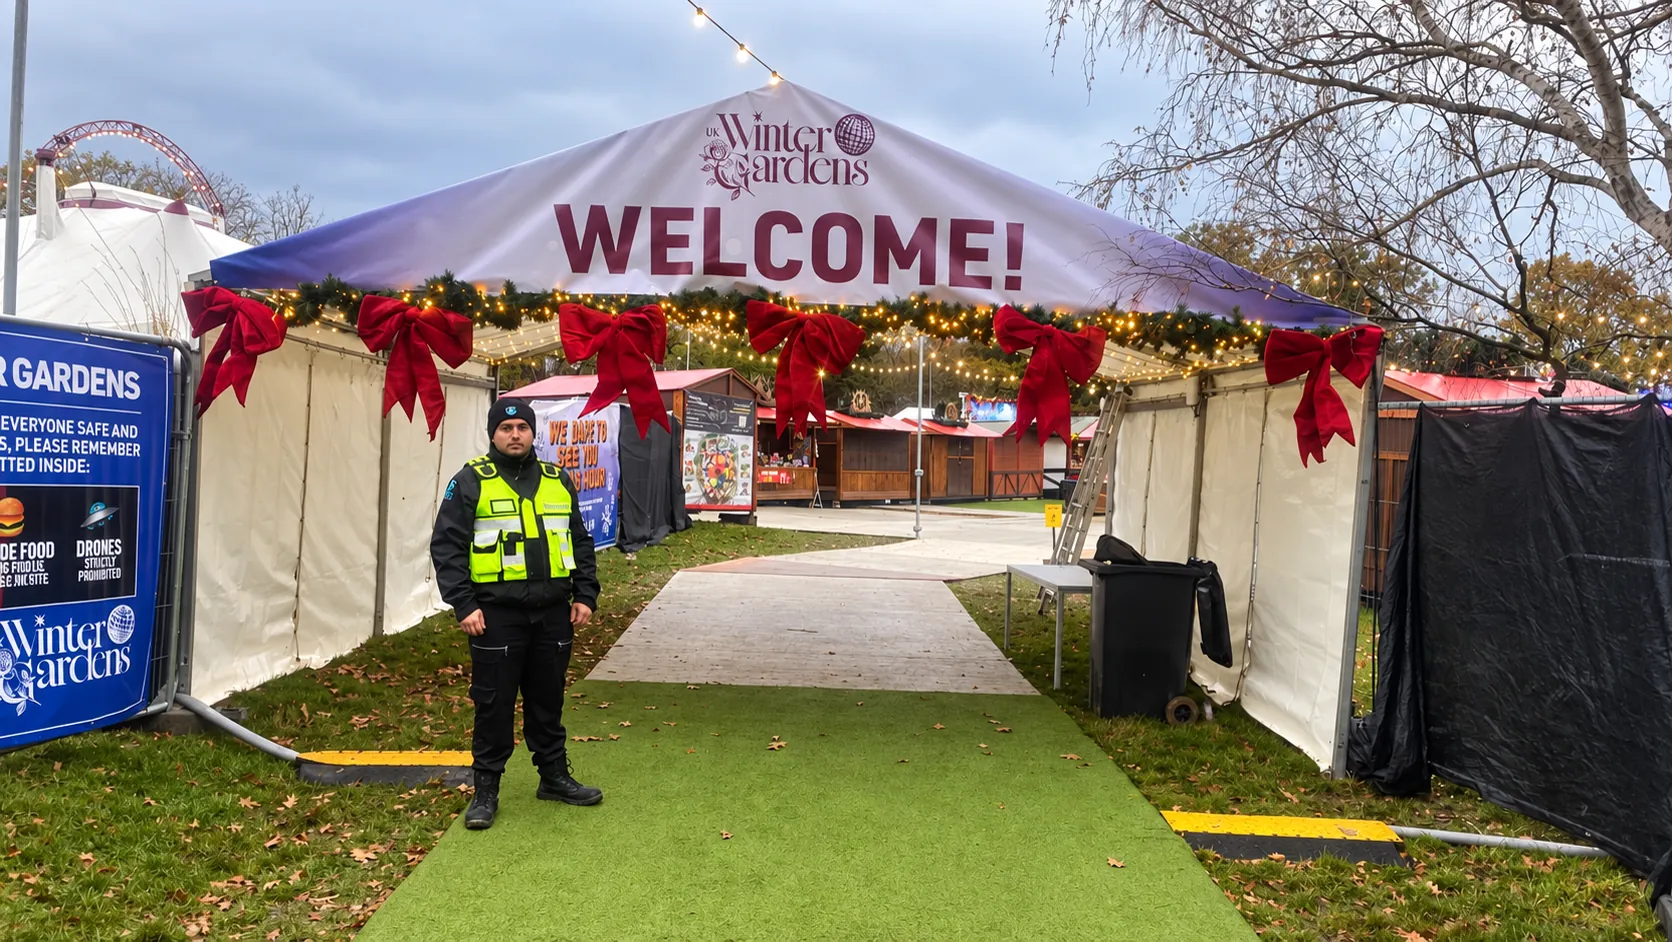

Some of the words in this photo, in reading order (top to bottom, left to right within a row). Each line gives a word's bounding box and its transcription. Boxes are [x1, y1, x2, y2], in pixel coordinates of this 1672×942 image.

[706, 127, 720, 137] UK
[716, 111, 832, 153] Winter
[713, 144, 869, 190] Gardens
[553, 203, 1025, 291] WELCOME!
[12, 357, 141, 400] GARDENS
[1, 416, 74, 434] EVERYONE
[77, 420, 109, 437] SAFE
[112, 424, 138, 439] AND
[549, 420, 568, 445] WE
[15, 437, 68, 454] PLEASE
[72, 440, 141, 457] REMEMBER
[556, 445, 580, 469] SEE
[582, 445, 599, 468] YOU
[38, 457, 91, 473] INSIDE:
[0, 542, 18, 560] DE
[20, 541, 55, 560] FOOD
[76, 538, 122, 558] DRONES
[0, 614, 106, 659] Winter
[0, 638, 131, 704] Gardens
